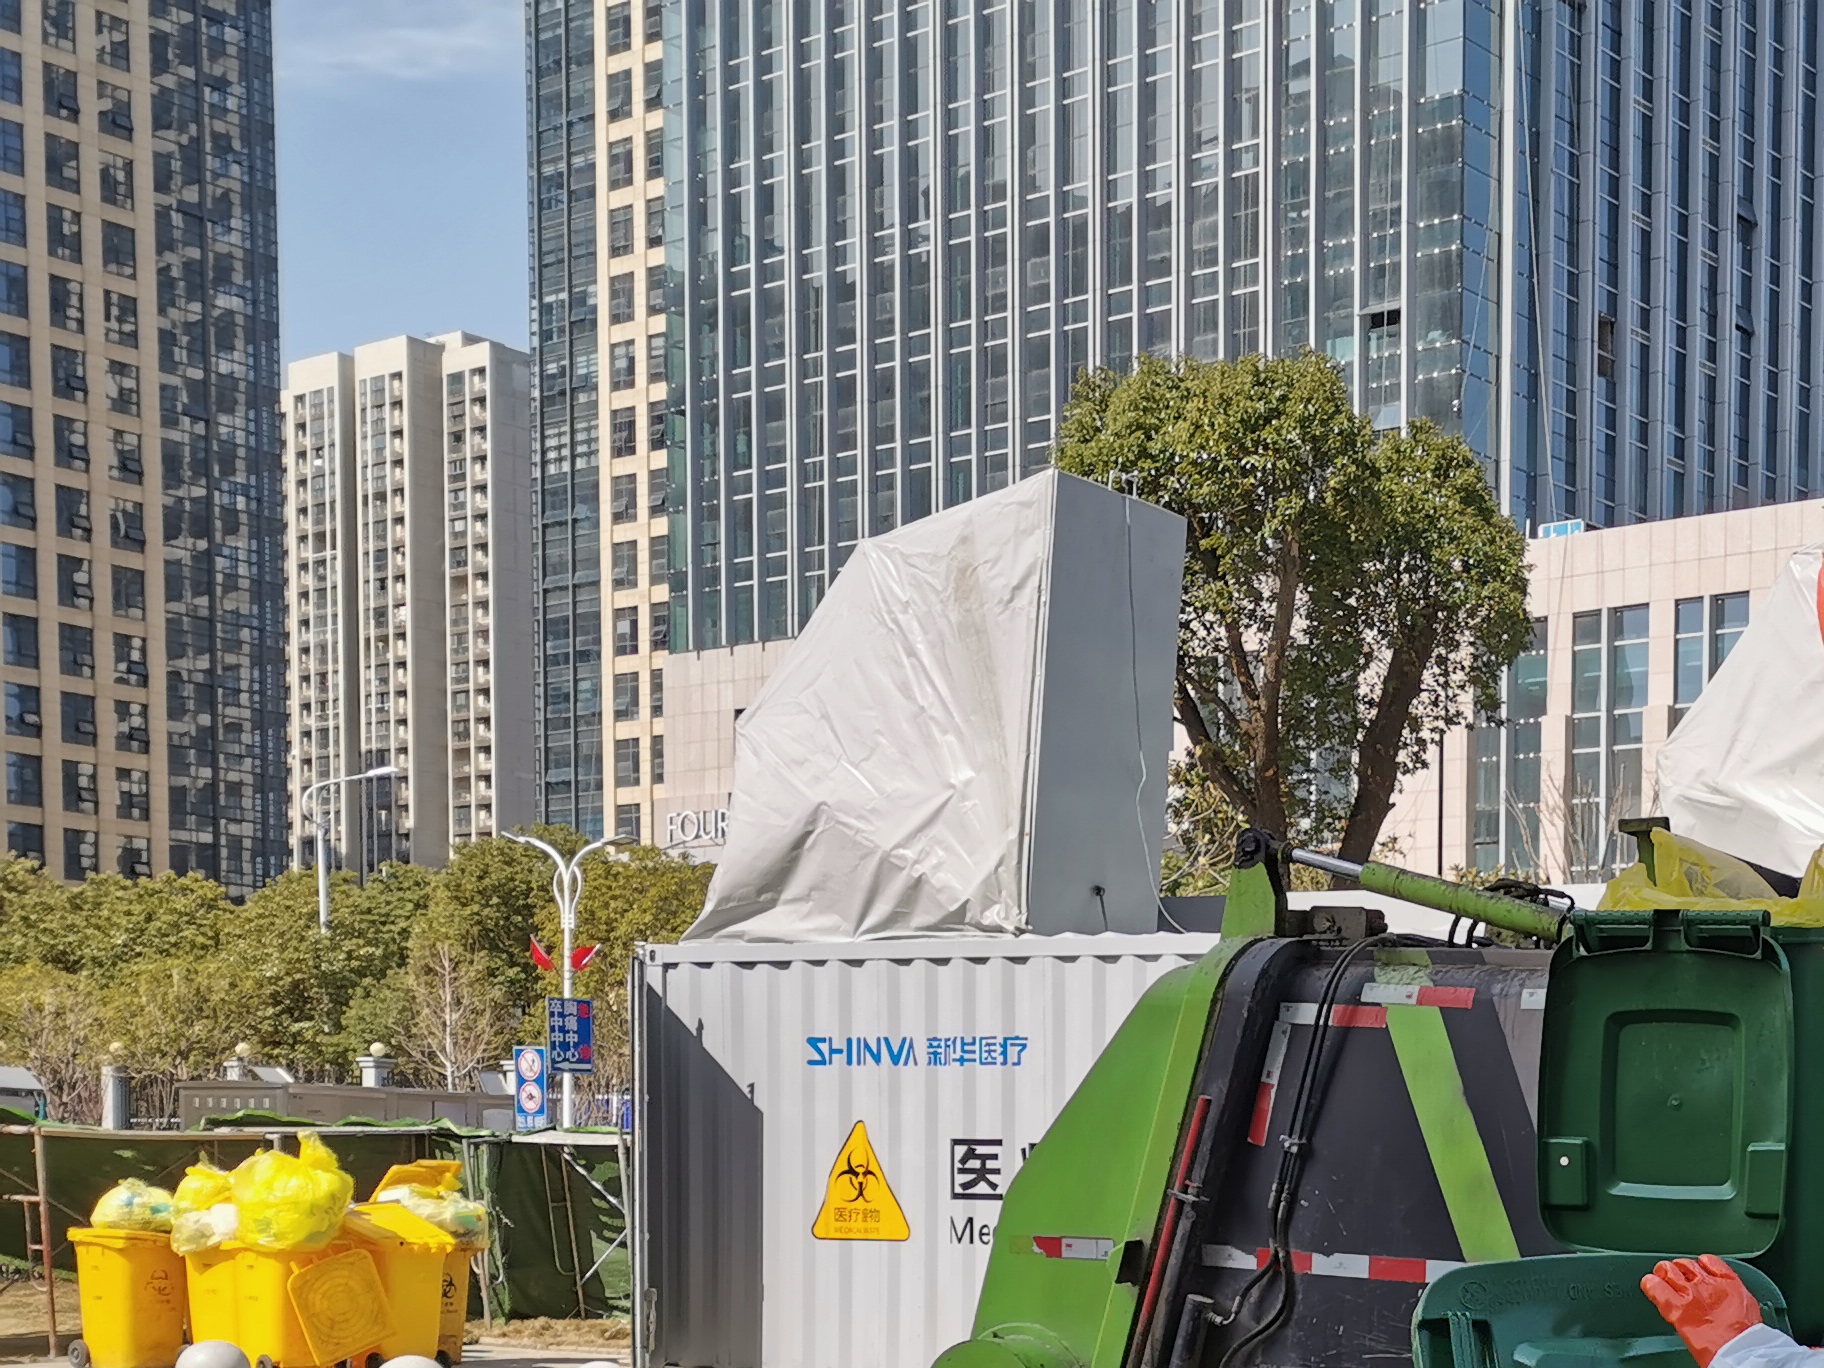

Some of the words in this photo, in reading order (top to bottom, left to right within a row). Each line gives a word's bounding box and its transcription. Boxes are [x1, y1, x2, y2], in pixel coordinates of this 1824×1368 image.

[806, 1036, 918, 1067] SHINVA
[926, 1035, 1029, 1067] 新华医疗
[949, 1138, 1038, 1201] 医
[949, 1215, 998, 1246] Me
